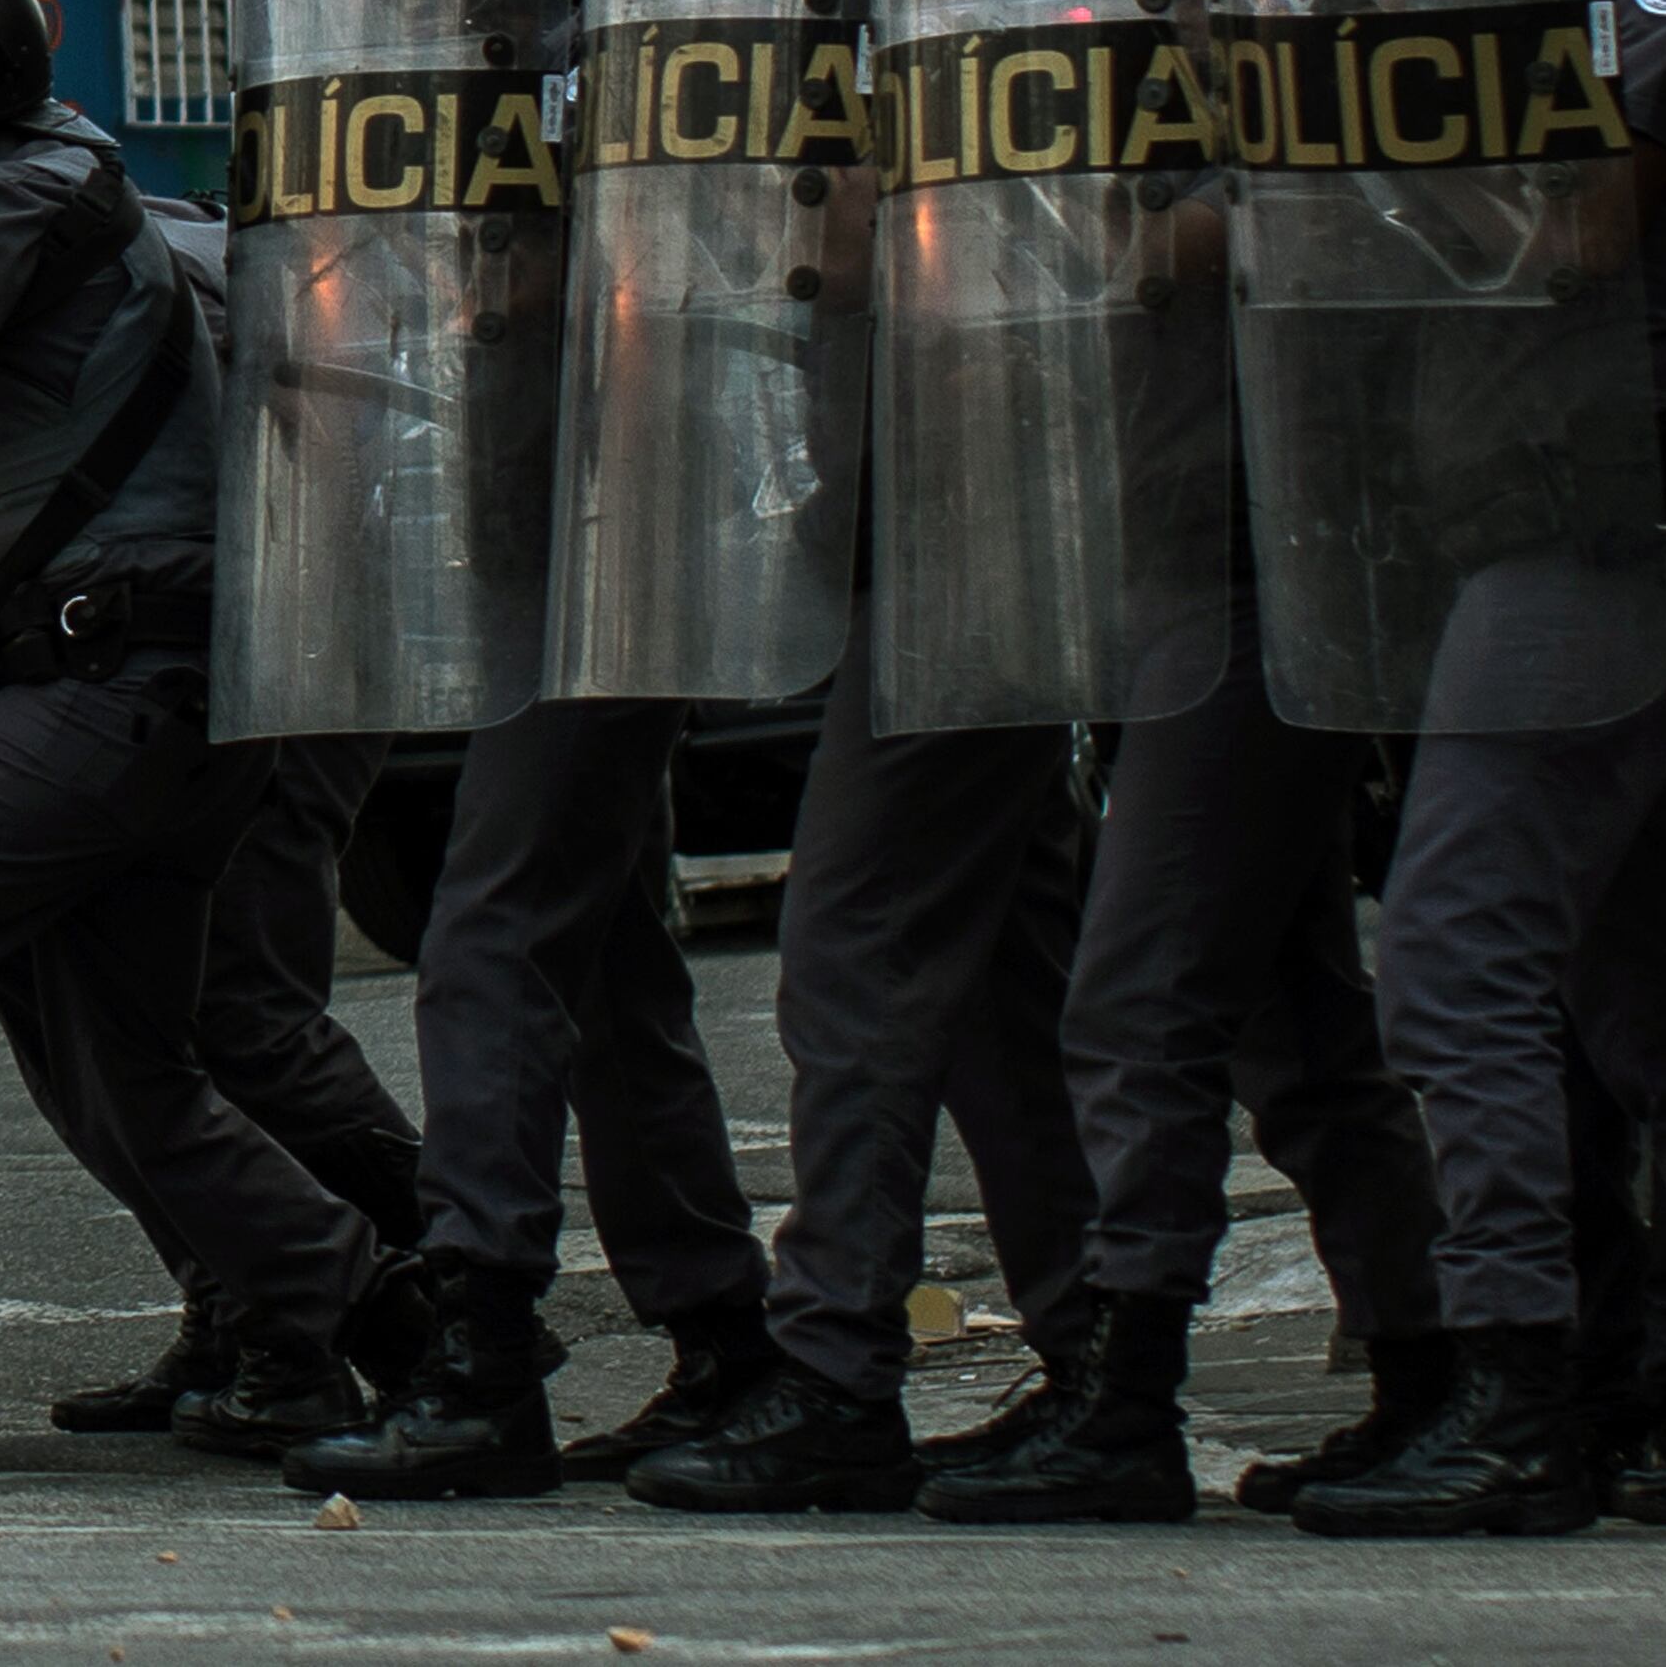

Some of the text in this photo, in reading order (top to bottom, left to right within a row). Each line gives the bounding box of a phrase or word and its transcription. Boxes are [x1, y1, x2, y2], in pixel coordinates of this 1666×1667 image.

[235, 76, 562, 223] OLÍCIA
[577, 23, 873, 167] LÍCIA
[875, 33, 1220, 193] OLÍCIA
